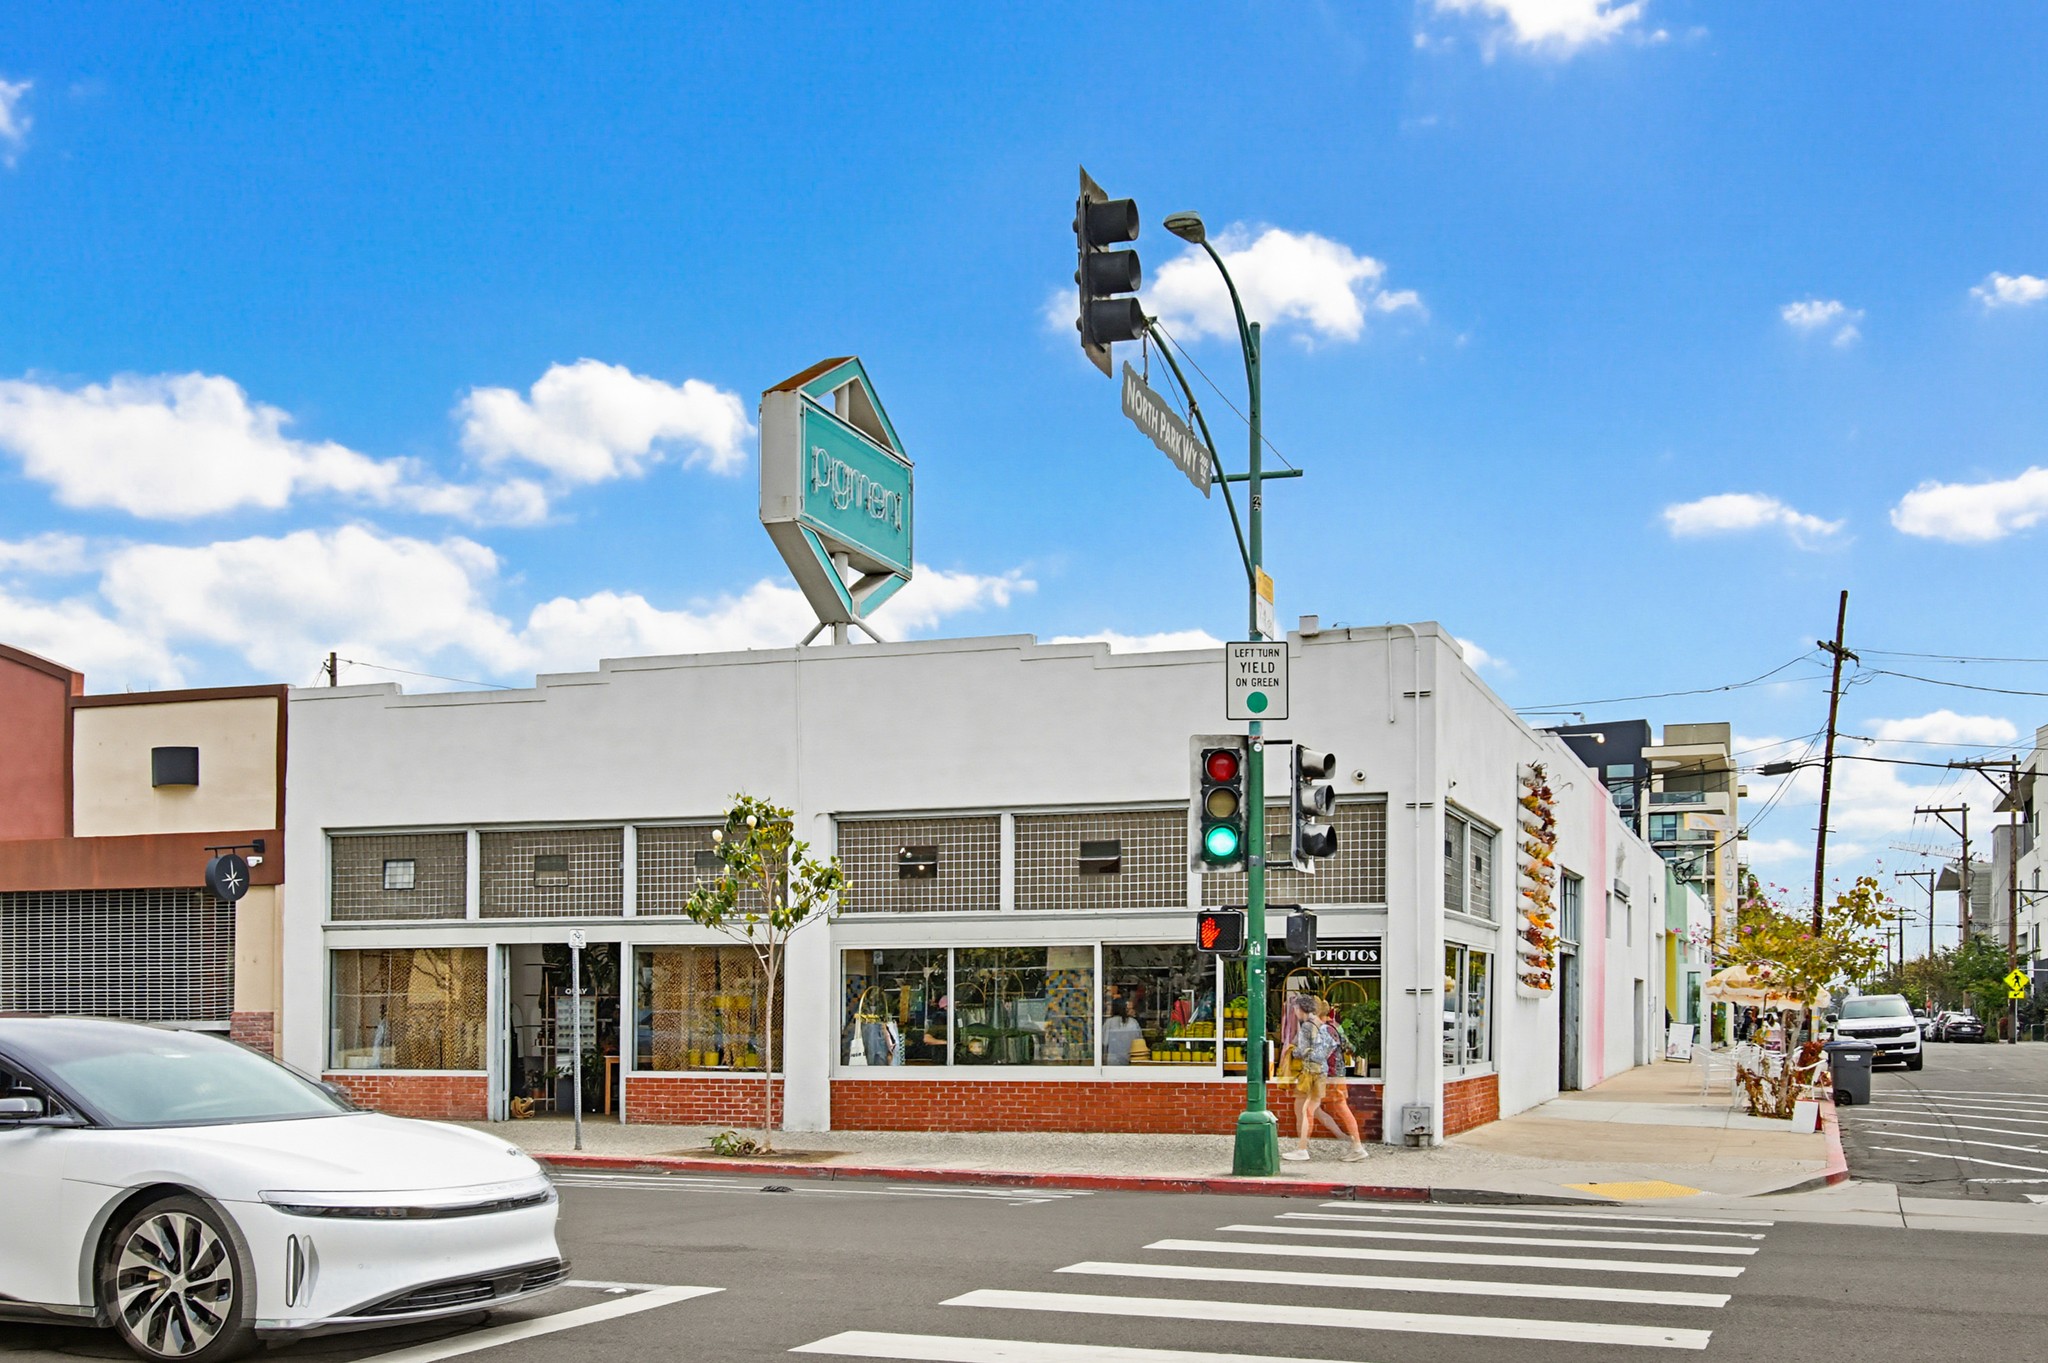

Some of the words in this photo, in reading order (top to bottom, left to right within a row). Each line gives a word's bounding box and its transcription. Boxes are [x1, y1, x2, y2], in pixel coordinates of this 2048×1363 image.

[1126, 375, 1159, 434] NORTH
[1234, 648, 1255, 658] LEFT
[1256, 648, 1280, 658] TURN
[1240, 661, 1275, 674] YIELD
[1235, 677, 1248, 687] ON
[1251, 677, 1280, 687] GREEN
[1315, 949, 1378, 962] PHOTOS
